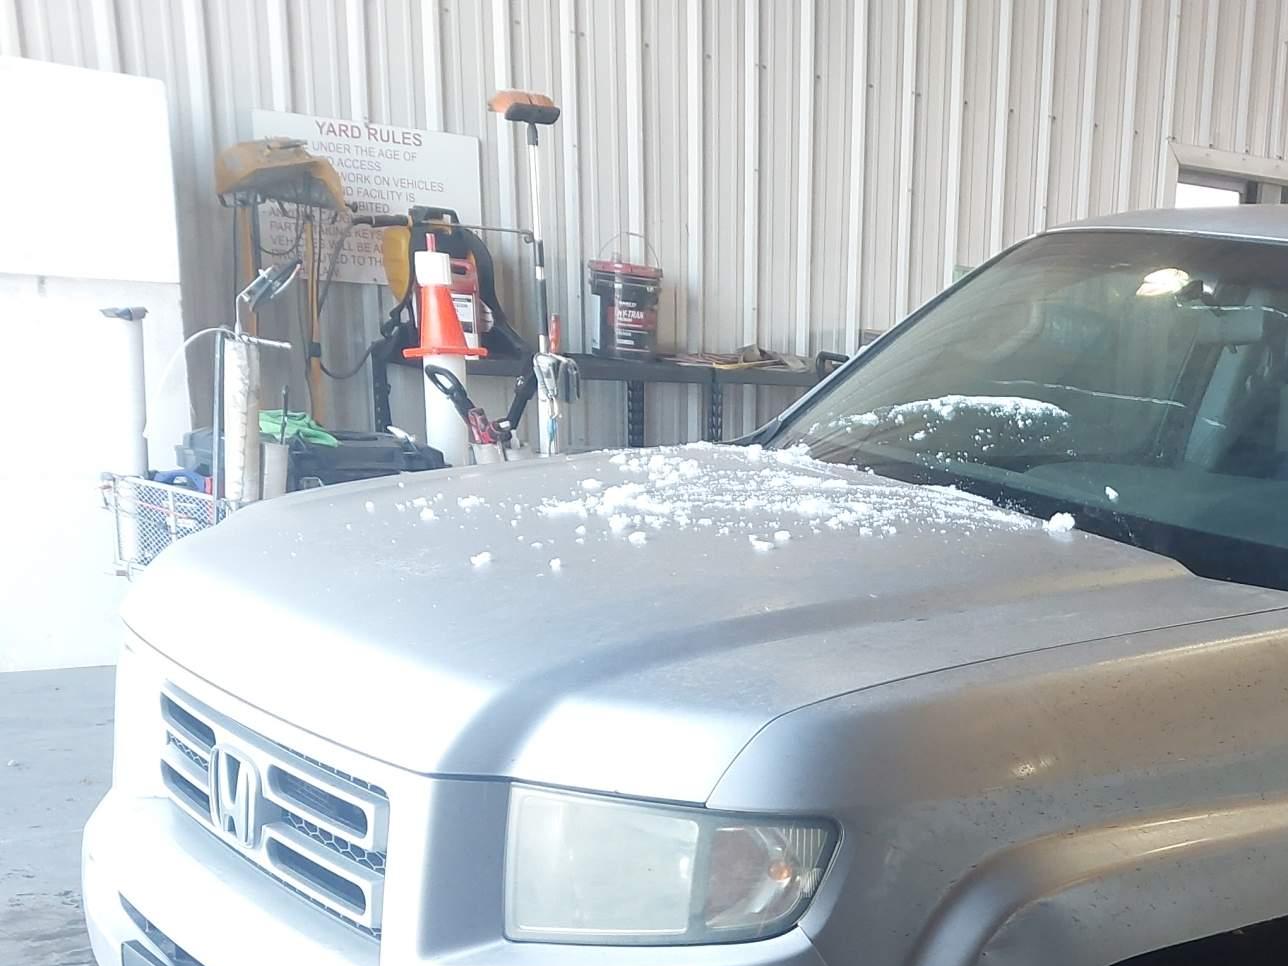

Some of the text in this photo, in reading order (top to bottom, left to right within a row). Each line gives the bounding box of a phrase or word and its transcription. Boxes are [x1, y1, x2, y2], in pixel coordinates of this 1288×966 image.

[315, 120, 423, 147] YARD RULES
[312, 141, 417, 161] UNDER THE AGE OF
[337, 158, 383, 171] ACCESS
[374, 175, 390, 187] ON
[357, 186, 403, 202] FACILITY
[405, 192, 416, 202] IS
